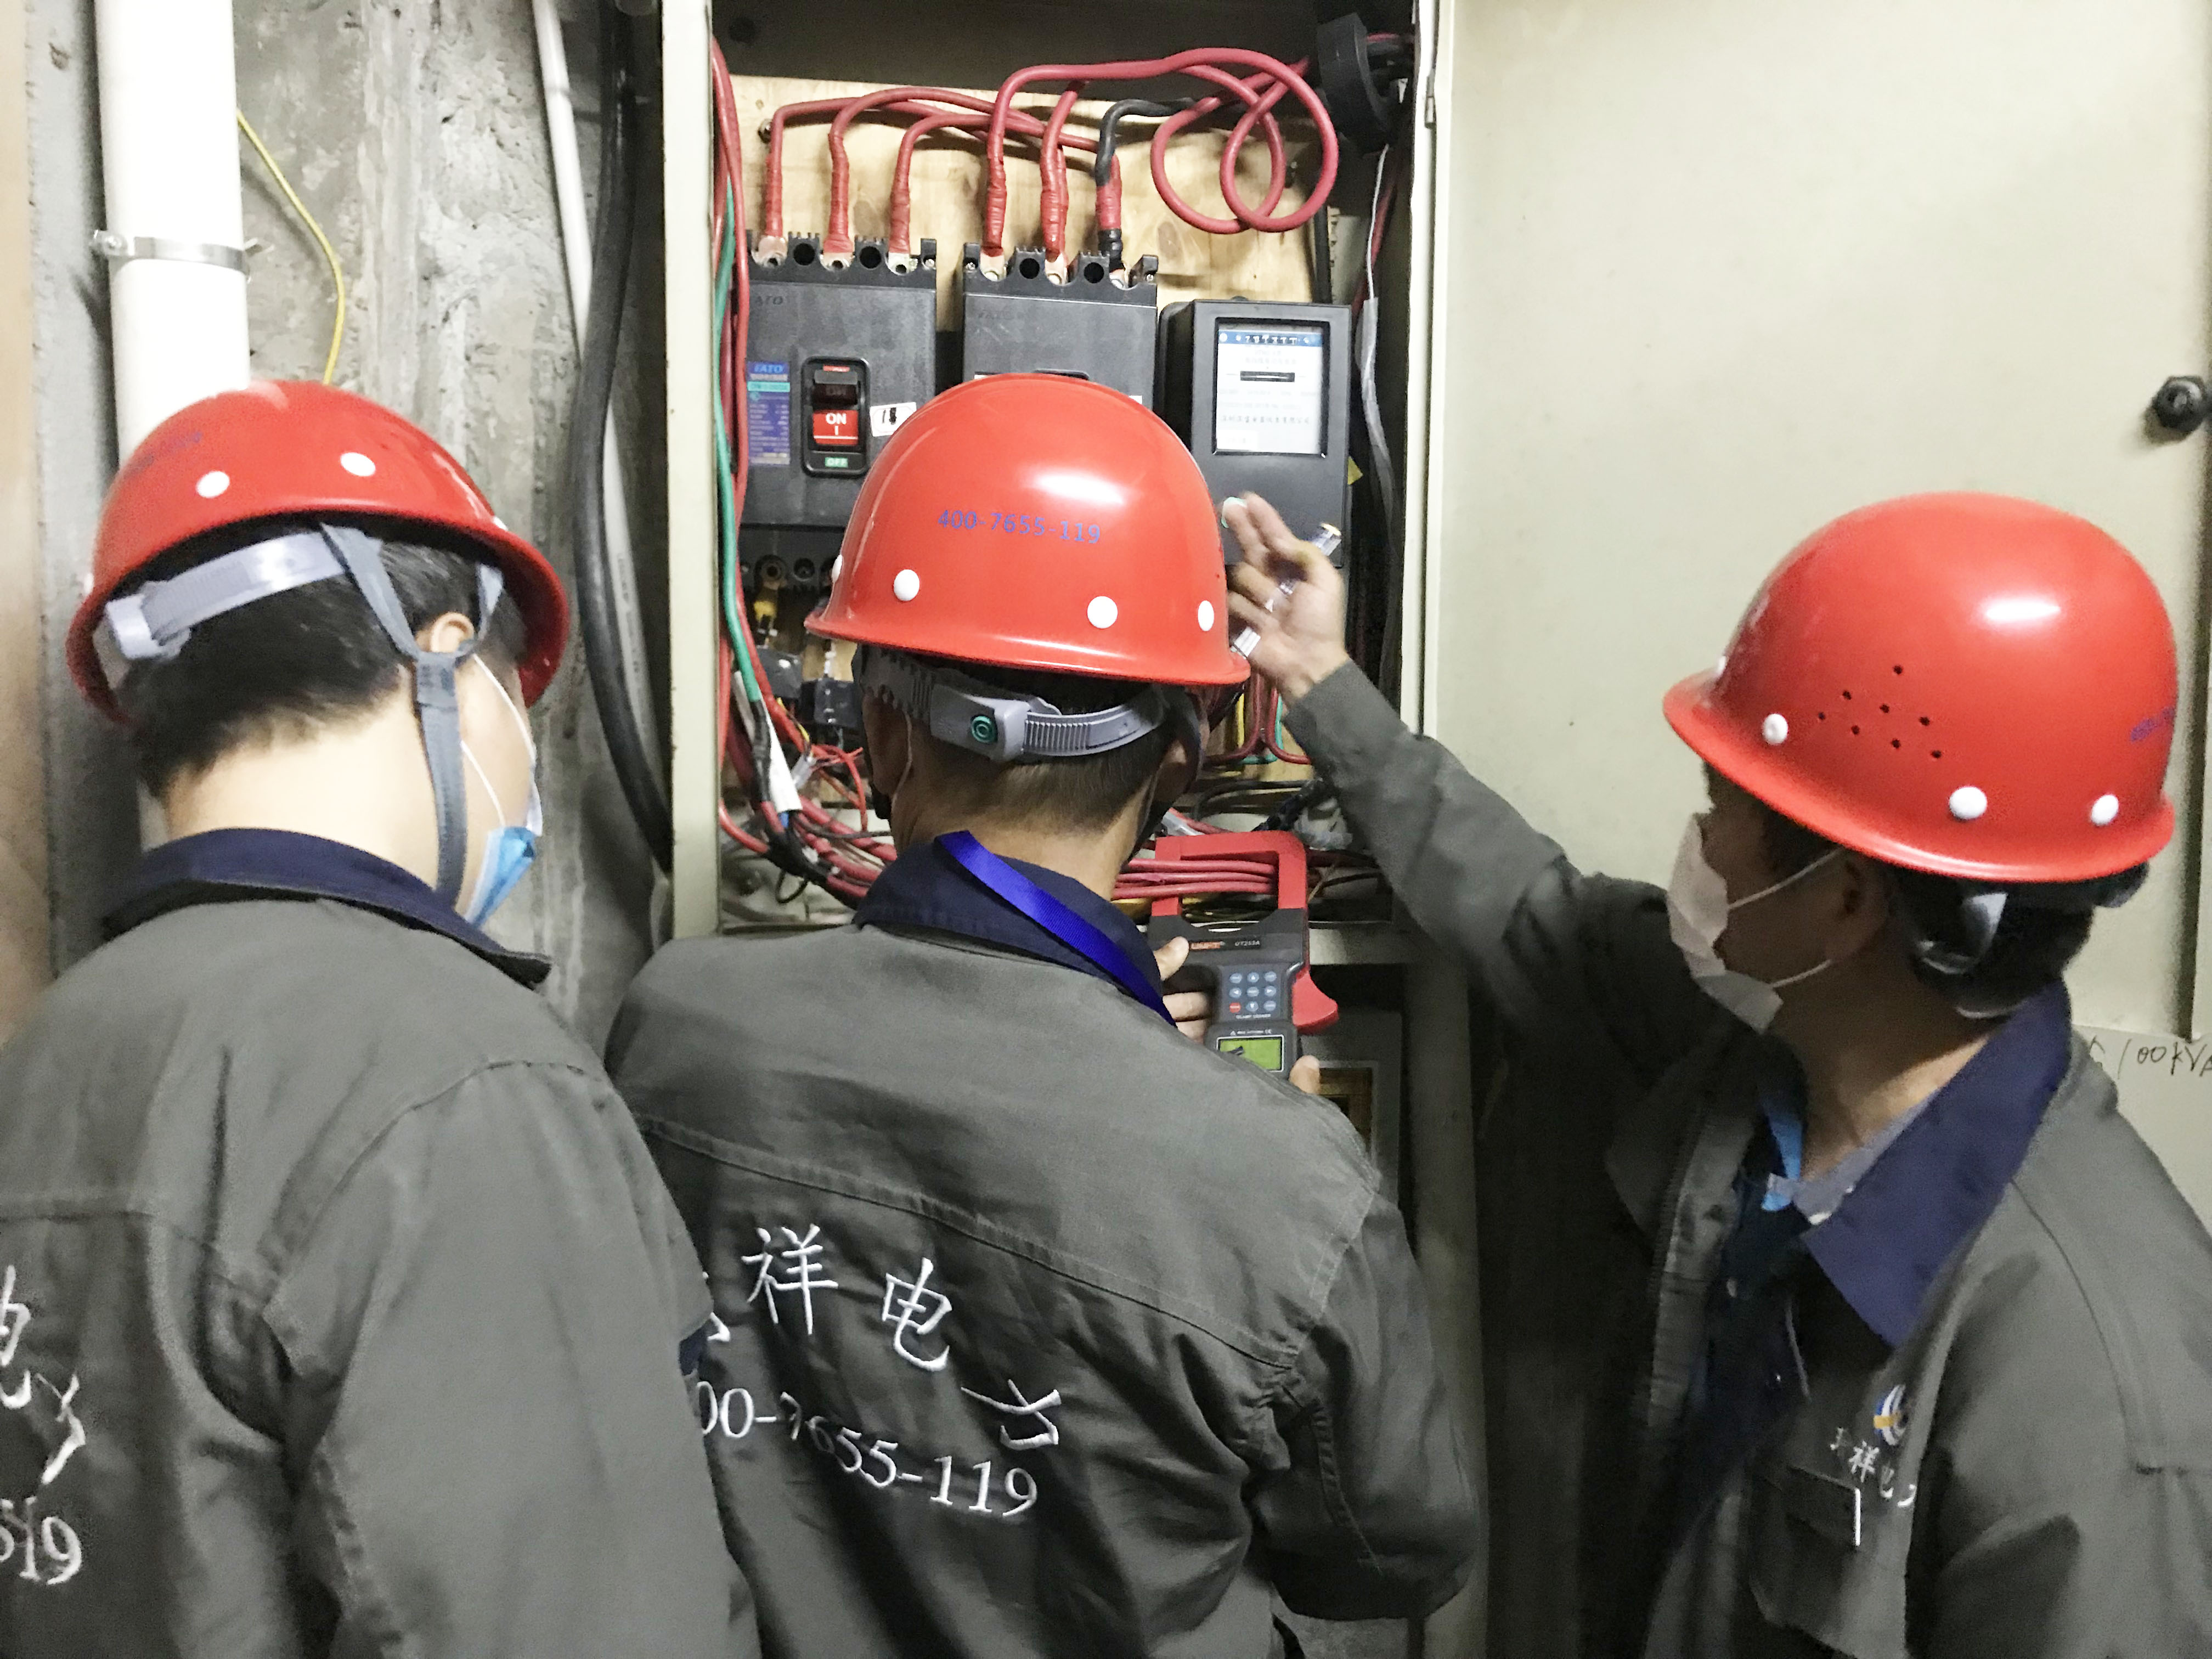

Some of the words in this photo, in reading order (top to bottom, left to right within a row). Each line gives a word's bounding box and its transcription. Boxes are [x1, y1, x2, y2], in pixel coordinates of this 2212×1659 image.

[826, 413, 847, 425] ON
[827, 458, 848, 466] OFF
[938, 510, 1101, 544] 400-7655-119
